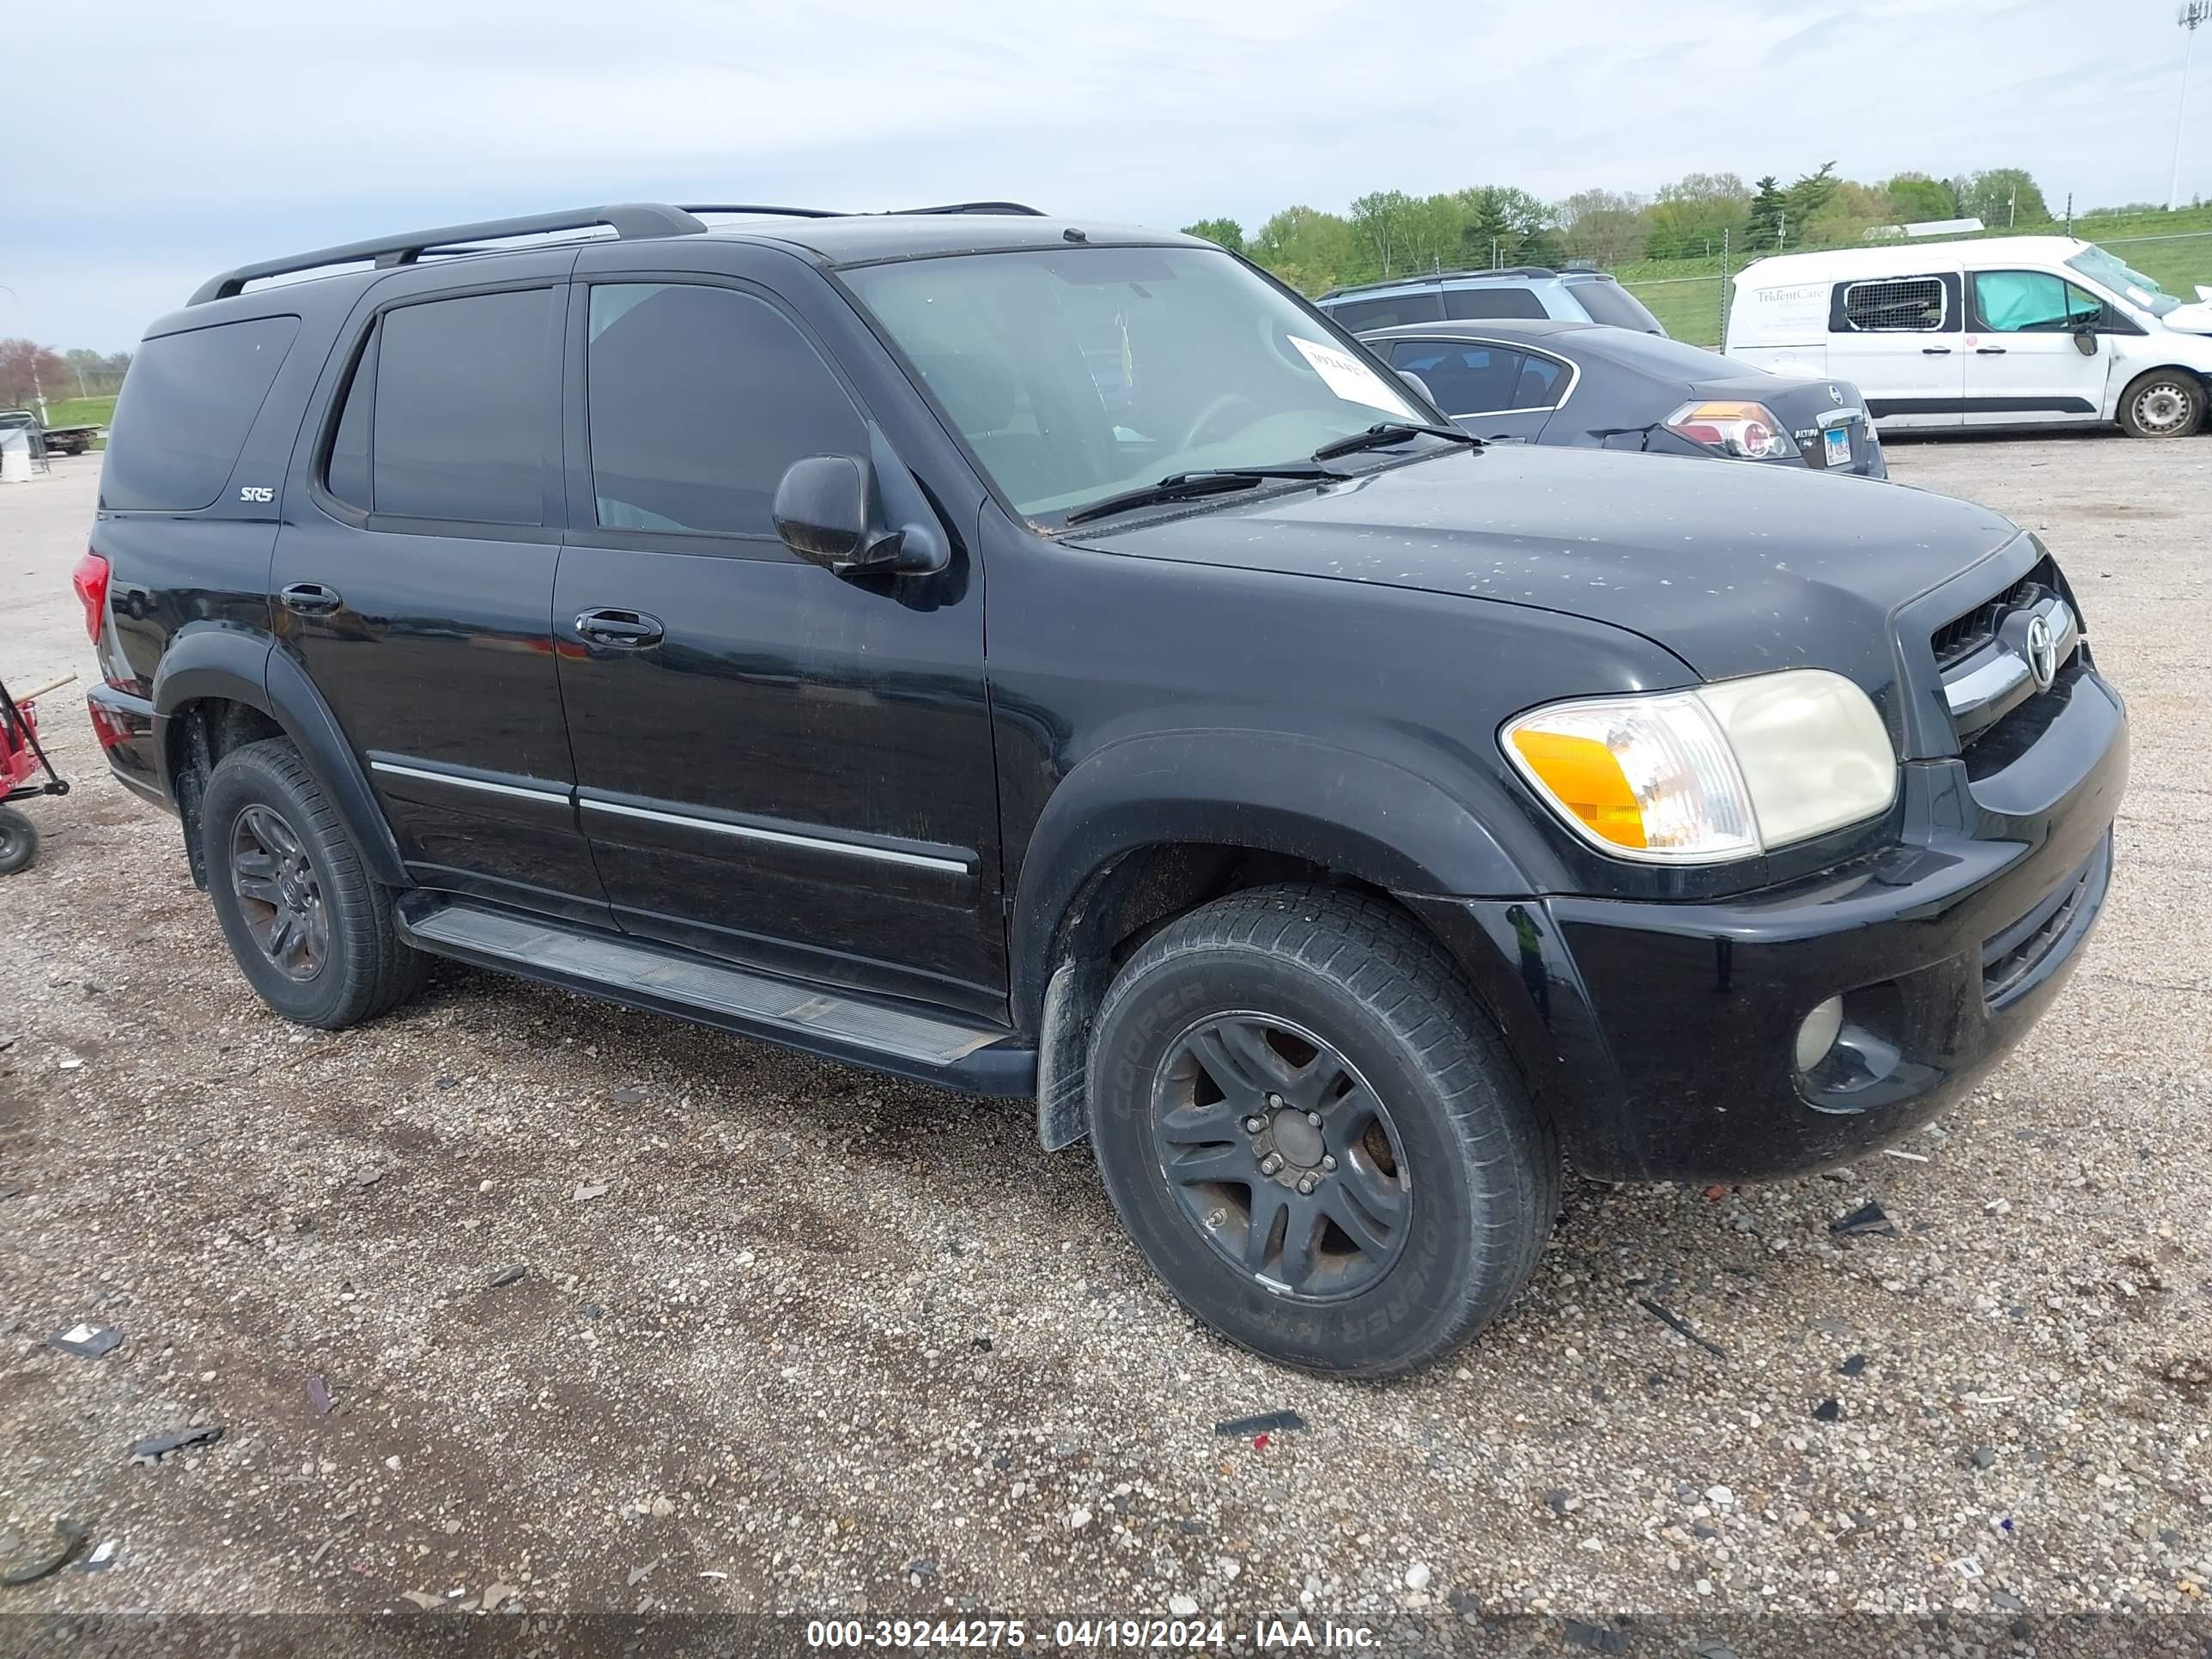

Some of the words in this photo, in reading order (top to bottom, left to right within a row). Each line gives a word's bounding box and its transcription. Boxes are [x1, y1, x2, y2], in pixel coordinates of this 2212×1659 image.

[1758, 289, 1824, 302] TridentCare
[240, 487, 274, 502] SR5
[1113, 981, 1206, 1120] COOPER
